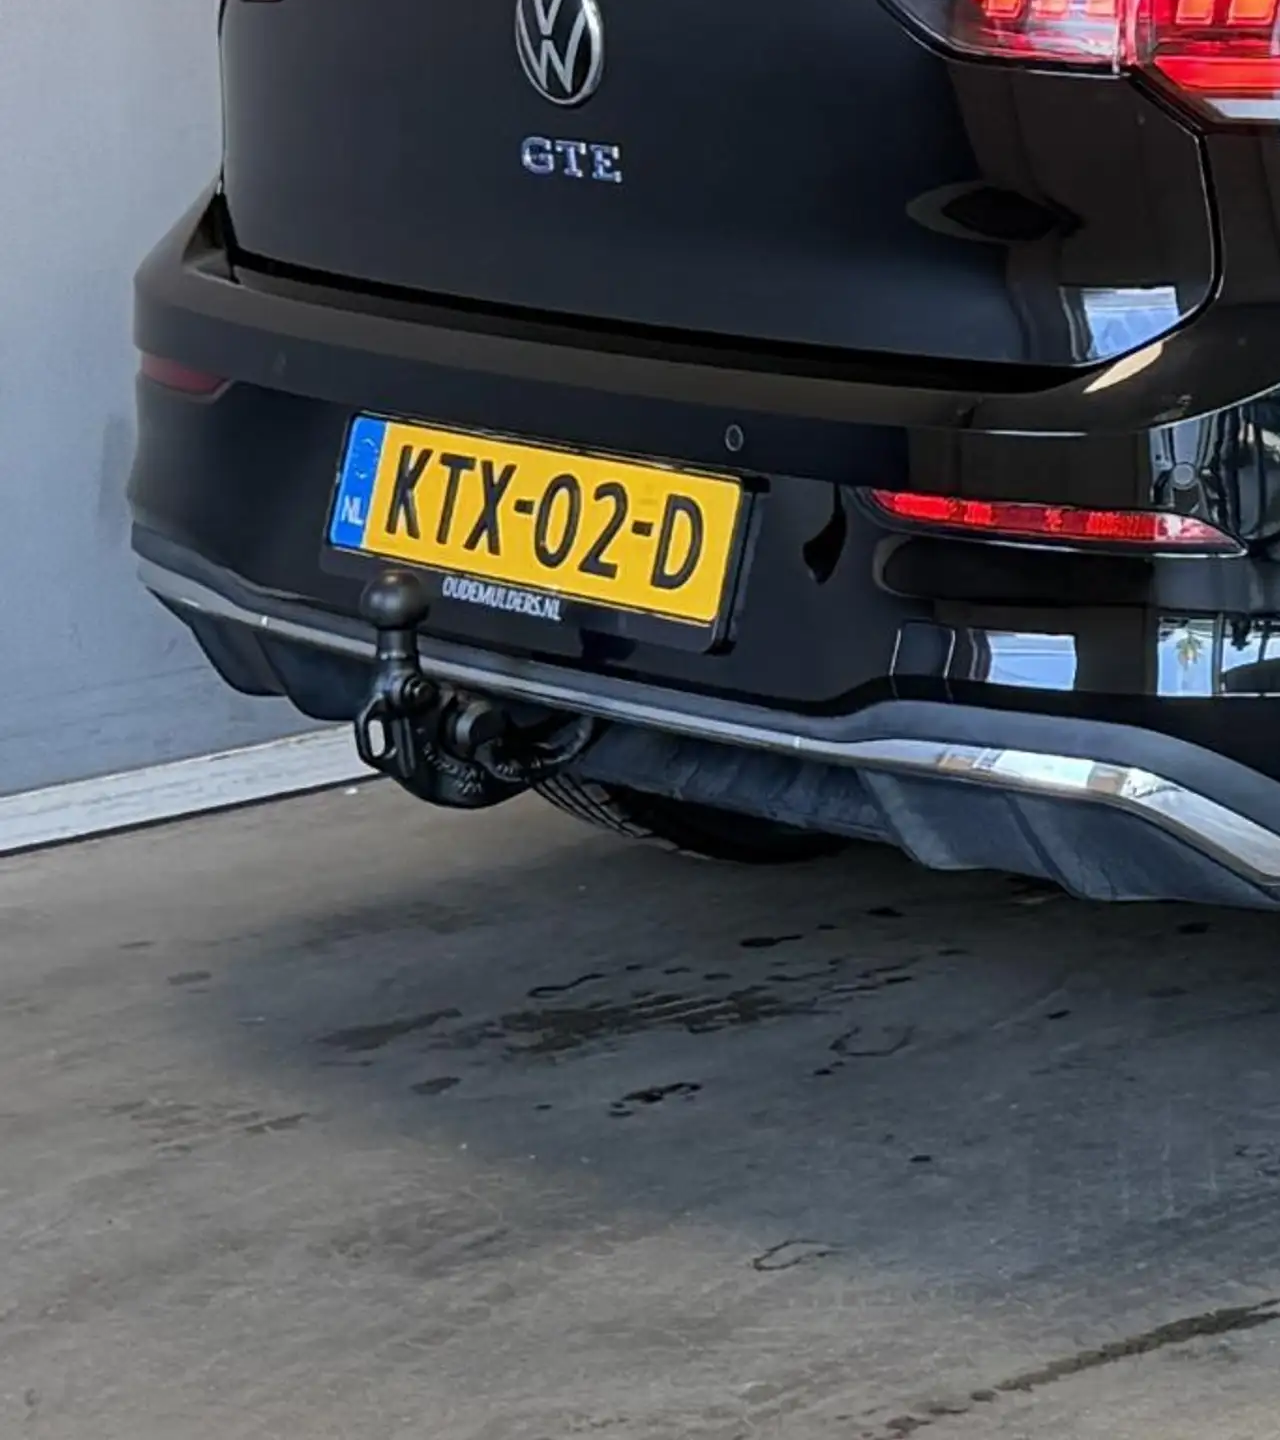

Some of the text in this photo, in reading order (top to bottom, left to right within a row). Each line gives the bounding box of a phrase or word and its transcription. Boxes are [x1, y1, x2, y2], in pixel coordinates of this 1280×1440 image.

[521, 136, 622, 183] GTE
[341, 444, 704, 591] NL KTX-02-D
[442, 576, 562, 622] OUDEMULDERS.NL
